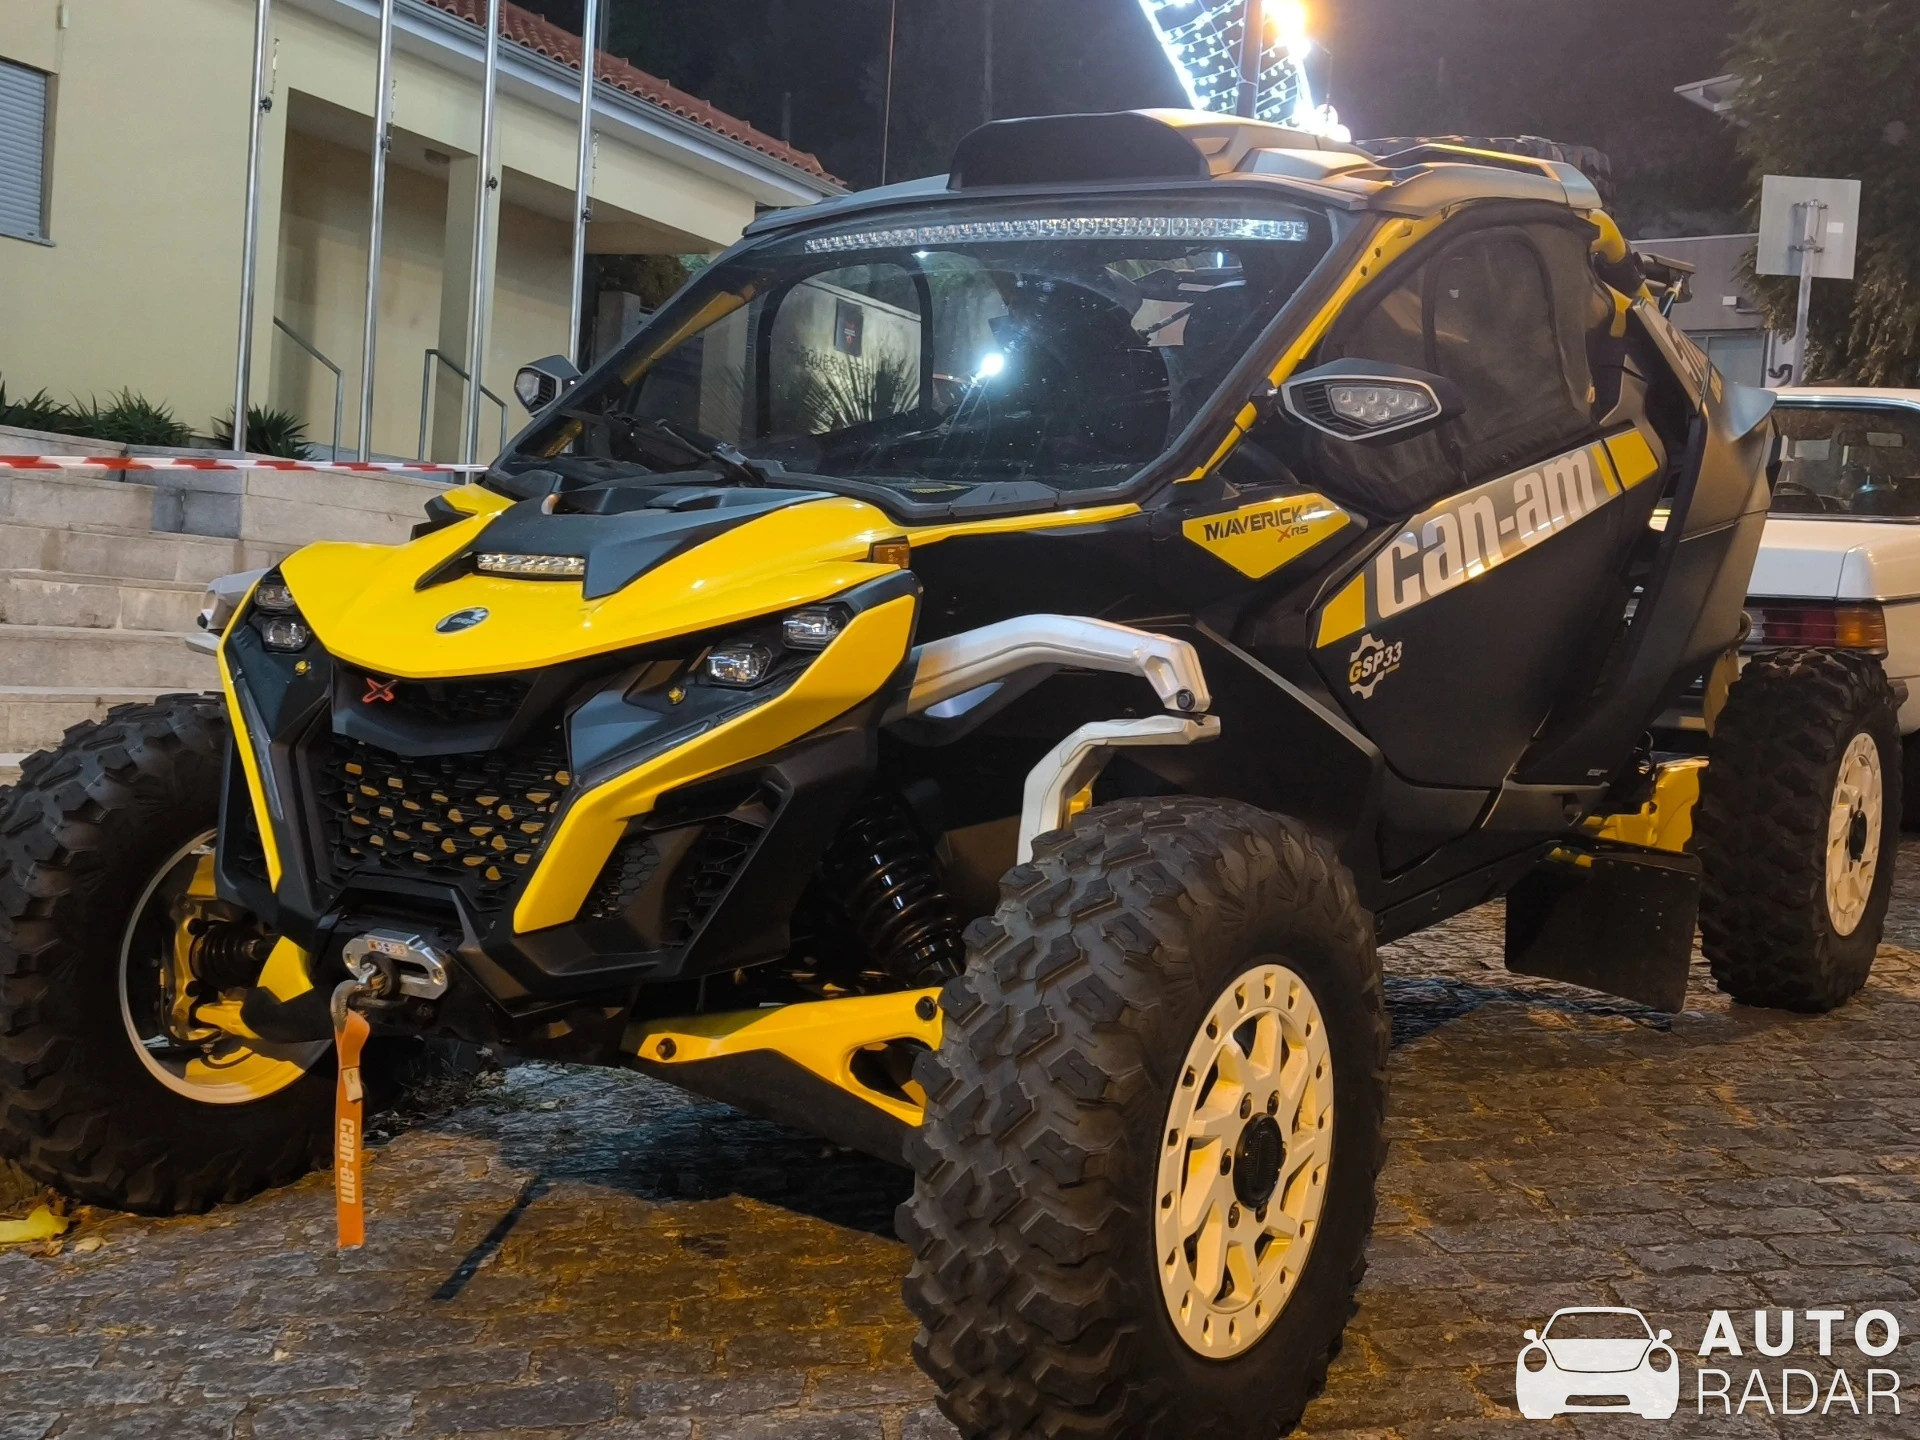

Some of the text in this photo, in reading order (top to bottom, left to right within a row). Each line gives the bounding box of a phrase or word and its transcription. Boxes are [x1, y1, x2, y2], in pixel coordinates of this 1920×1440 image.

[1202, 505, 1304, 541] MAVERICK
[1376, 450, 1598, 619] can-am
[1349, 641, 1403, 683] GSP33
[339, 1117, 357, 1205] can-am
